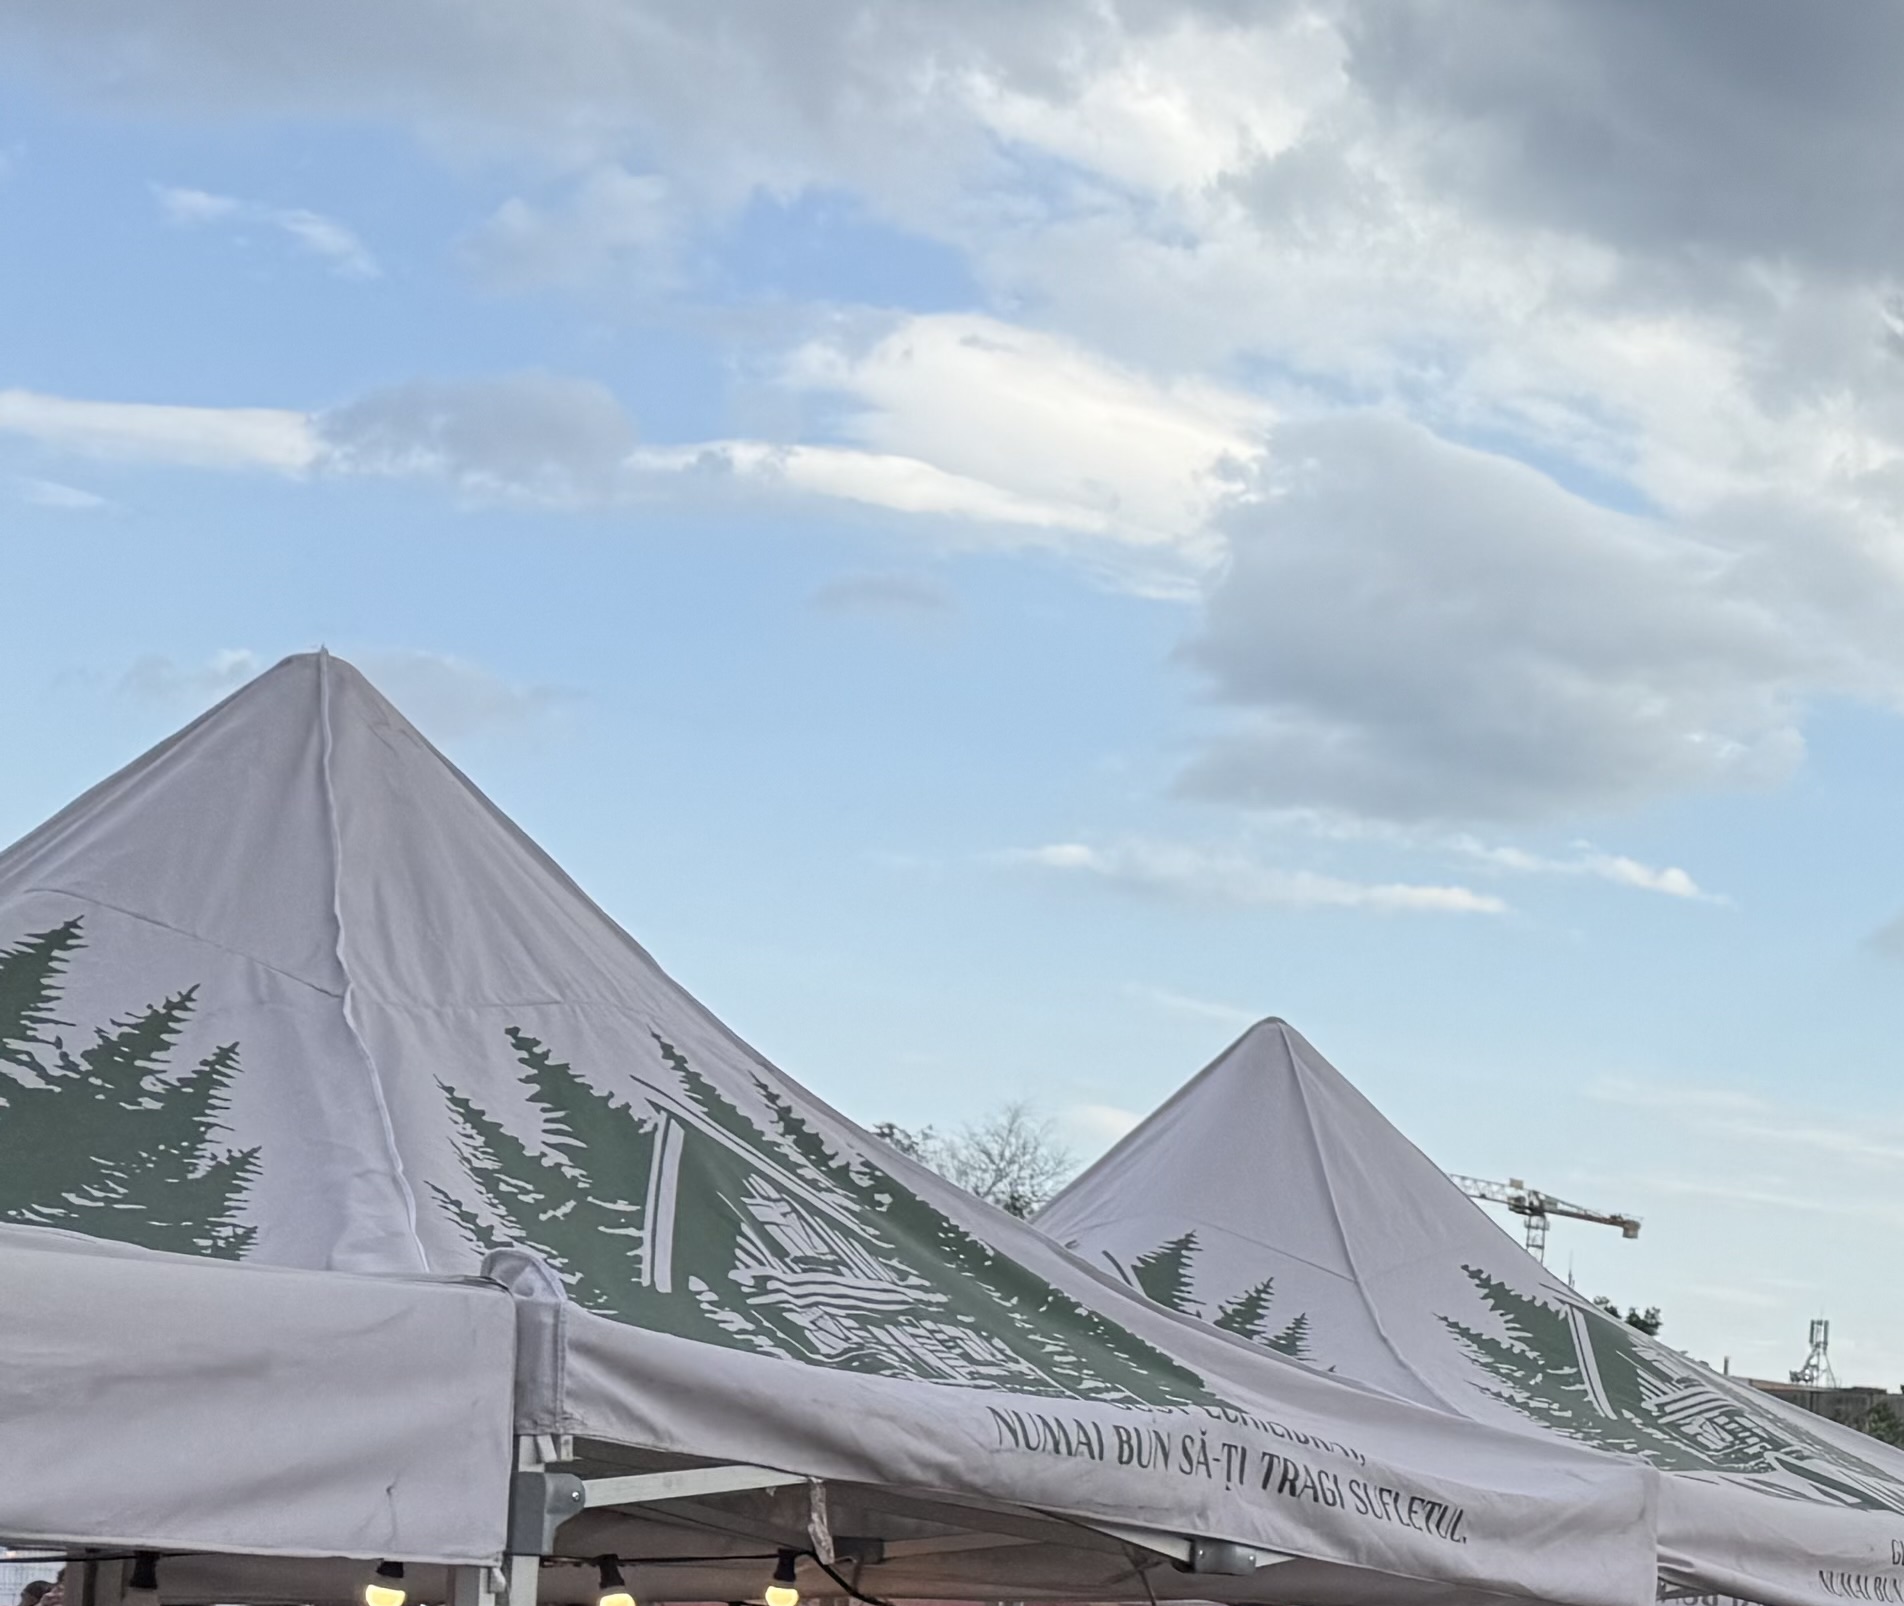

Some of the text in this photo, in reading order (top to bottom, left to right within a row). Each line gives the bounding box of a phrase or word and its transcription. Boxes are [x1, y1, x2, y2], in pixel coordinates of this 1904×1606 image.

[986, 1405, 1467, 1544] NUMAI BUN SĂ-ȚI TRAGI SUFLETUL.
